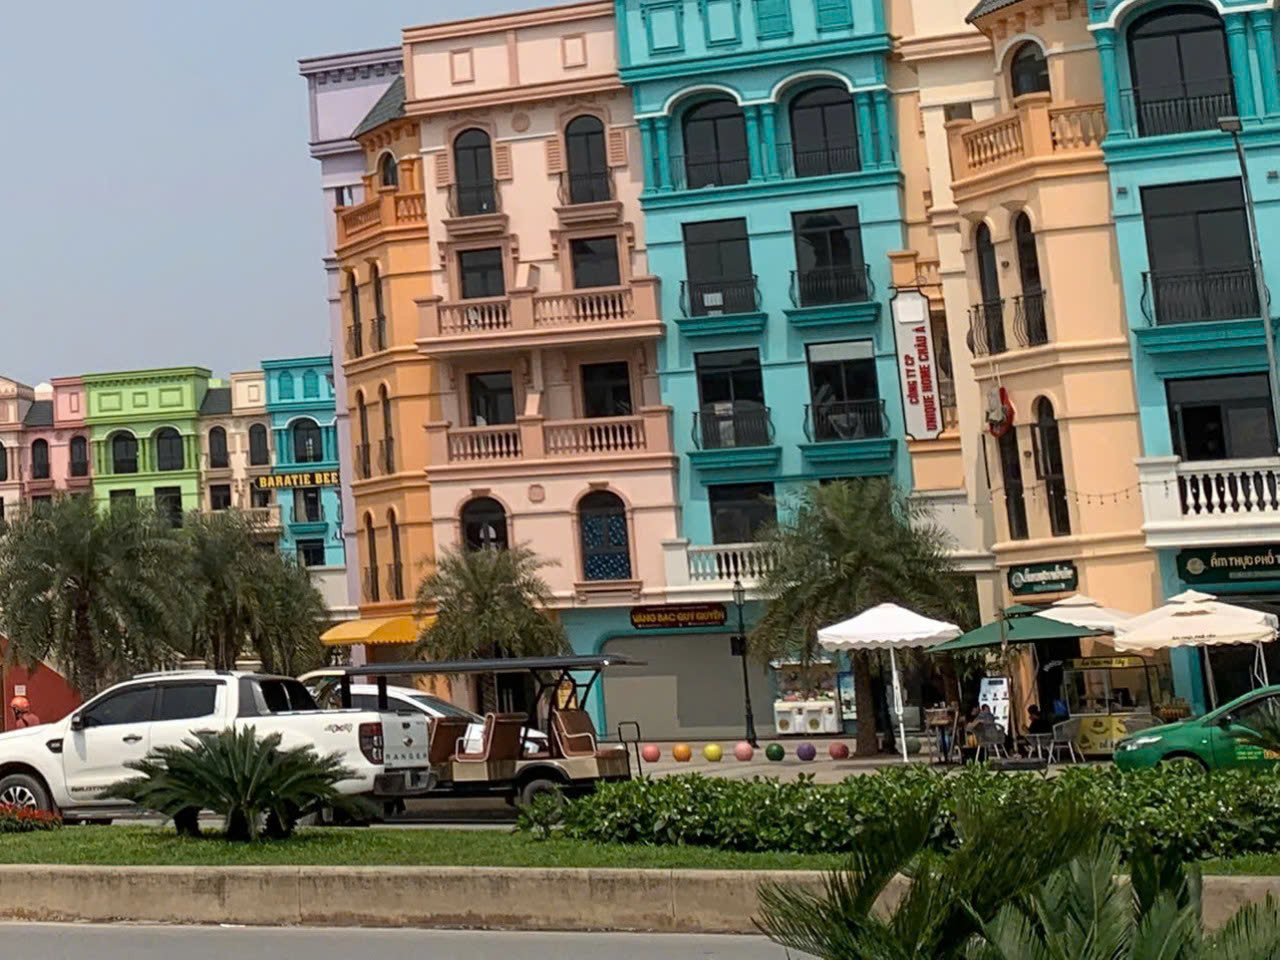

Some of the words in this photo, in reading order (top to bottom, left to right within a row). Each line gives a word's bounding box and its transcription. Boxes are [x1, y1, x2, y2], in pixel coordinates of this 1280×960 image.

[904, 354, 915, 366] CP
[906, 367, 917, 380] TY
[919, 364, 933, 393] HOME
[923, 394, 937, 432] UNIQUE
[260, 474, 311, 488] BARATIE
[315, 472, 338, 484] BEE
[385, 752, 428, 760] RANGER
